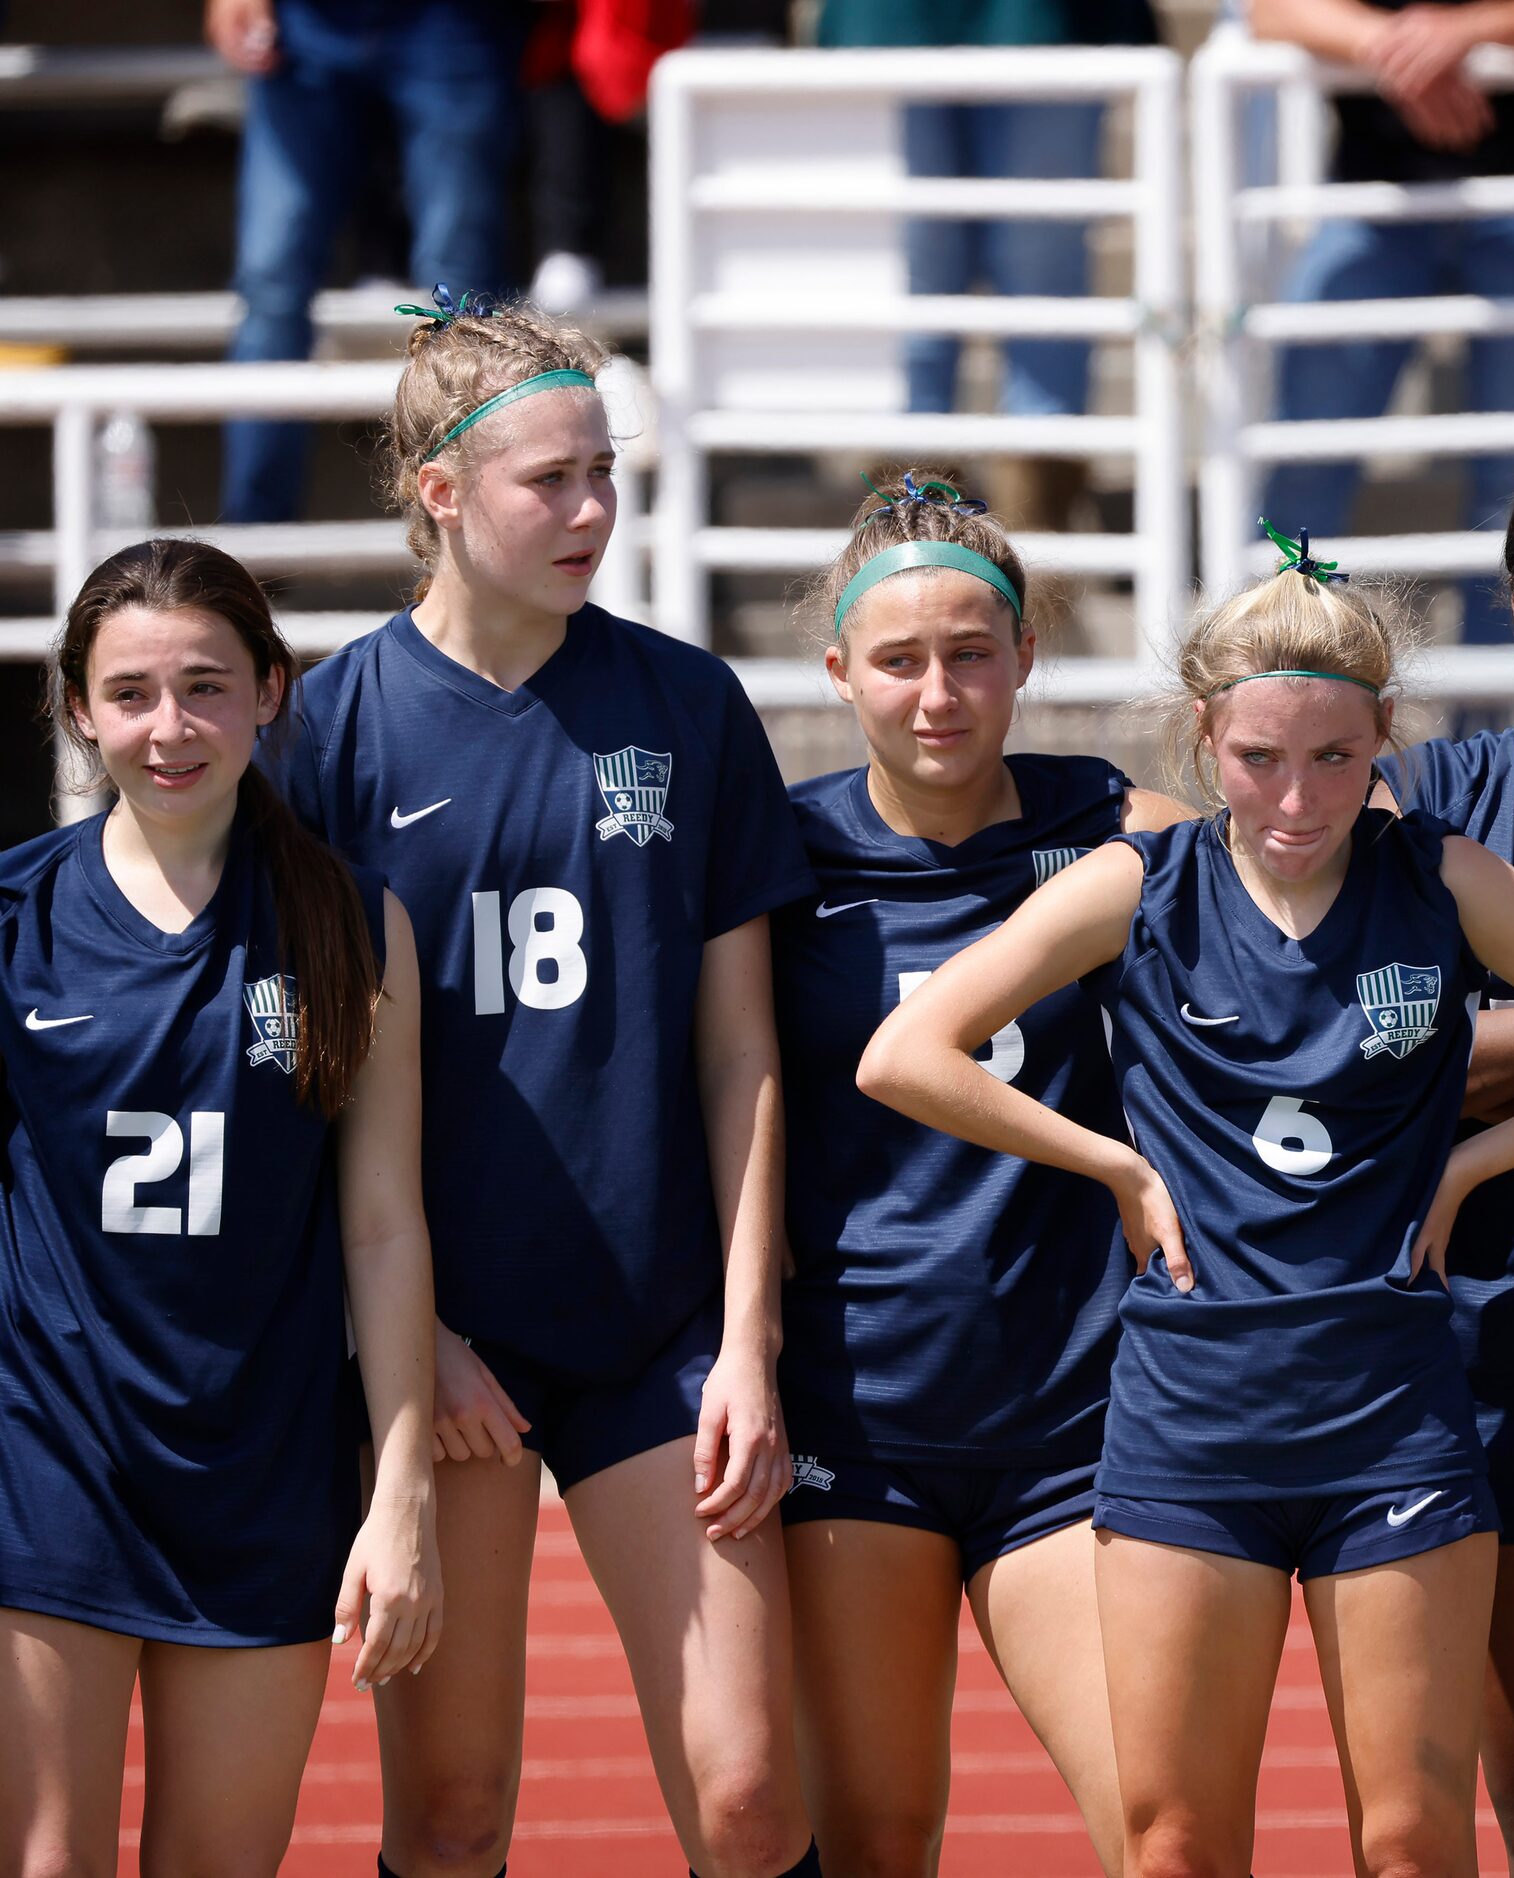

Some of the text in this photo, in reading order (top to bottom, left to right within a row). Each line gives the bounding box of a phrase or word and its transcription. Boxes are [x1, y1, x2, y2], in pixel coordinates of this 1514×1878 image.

[622, 813, 654, 823] REEDY
[471, 887, 588, 1015] 18
[256, 1039, 297, 1059] EST REED
[1387, 1028, 1421, 1041] REEDY
[1251, 1095, 1333, 1176] 6
[101, 1111, 226, 1236] 21
